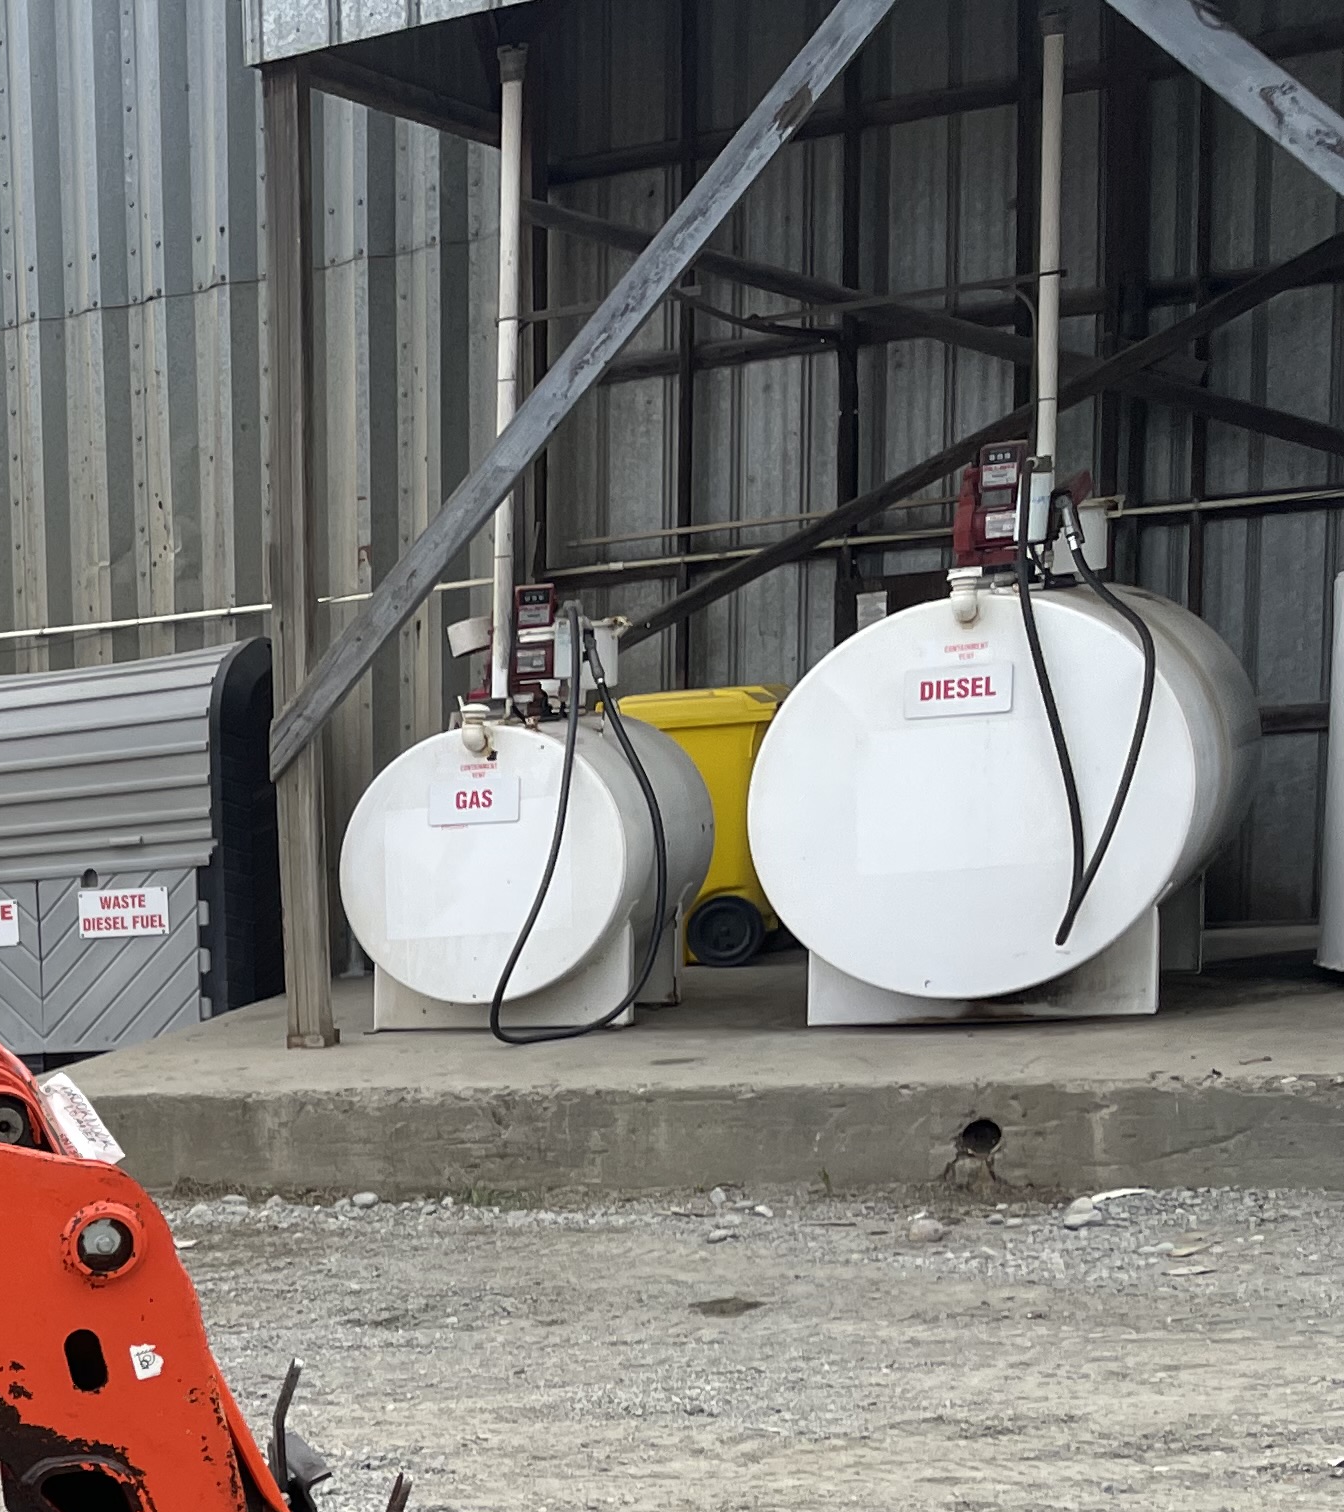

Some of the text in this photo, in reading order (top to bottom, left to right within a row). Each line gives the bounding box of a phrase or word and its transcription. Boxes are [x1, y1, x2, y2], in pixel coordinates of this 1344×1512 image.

[920, 676, 997, 702] DIESEL
[455, 789, 493, 810] GAS
[99, 894, 147, 910] WASTE
[83, 914, 166, 933] DIESEL FUEL
